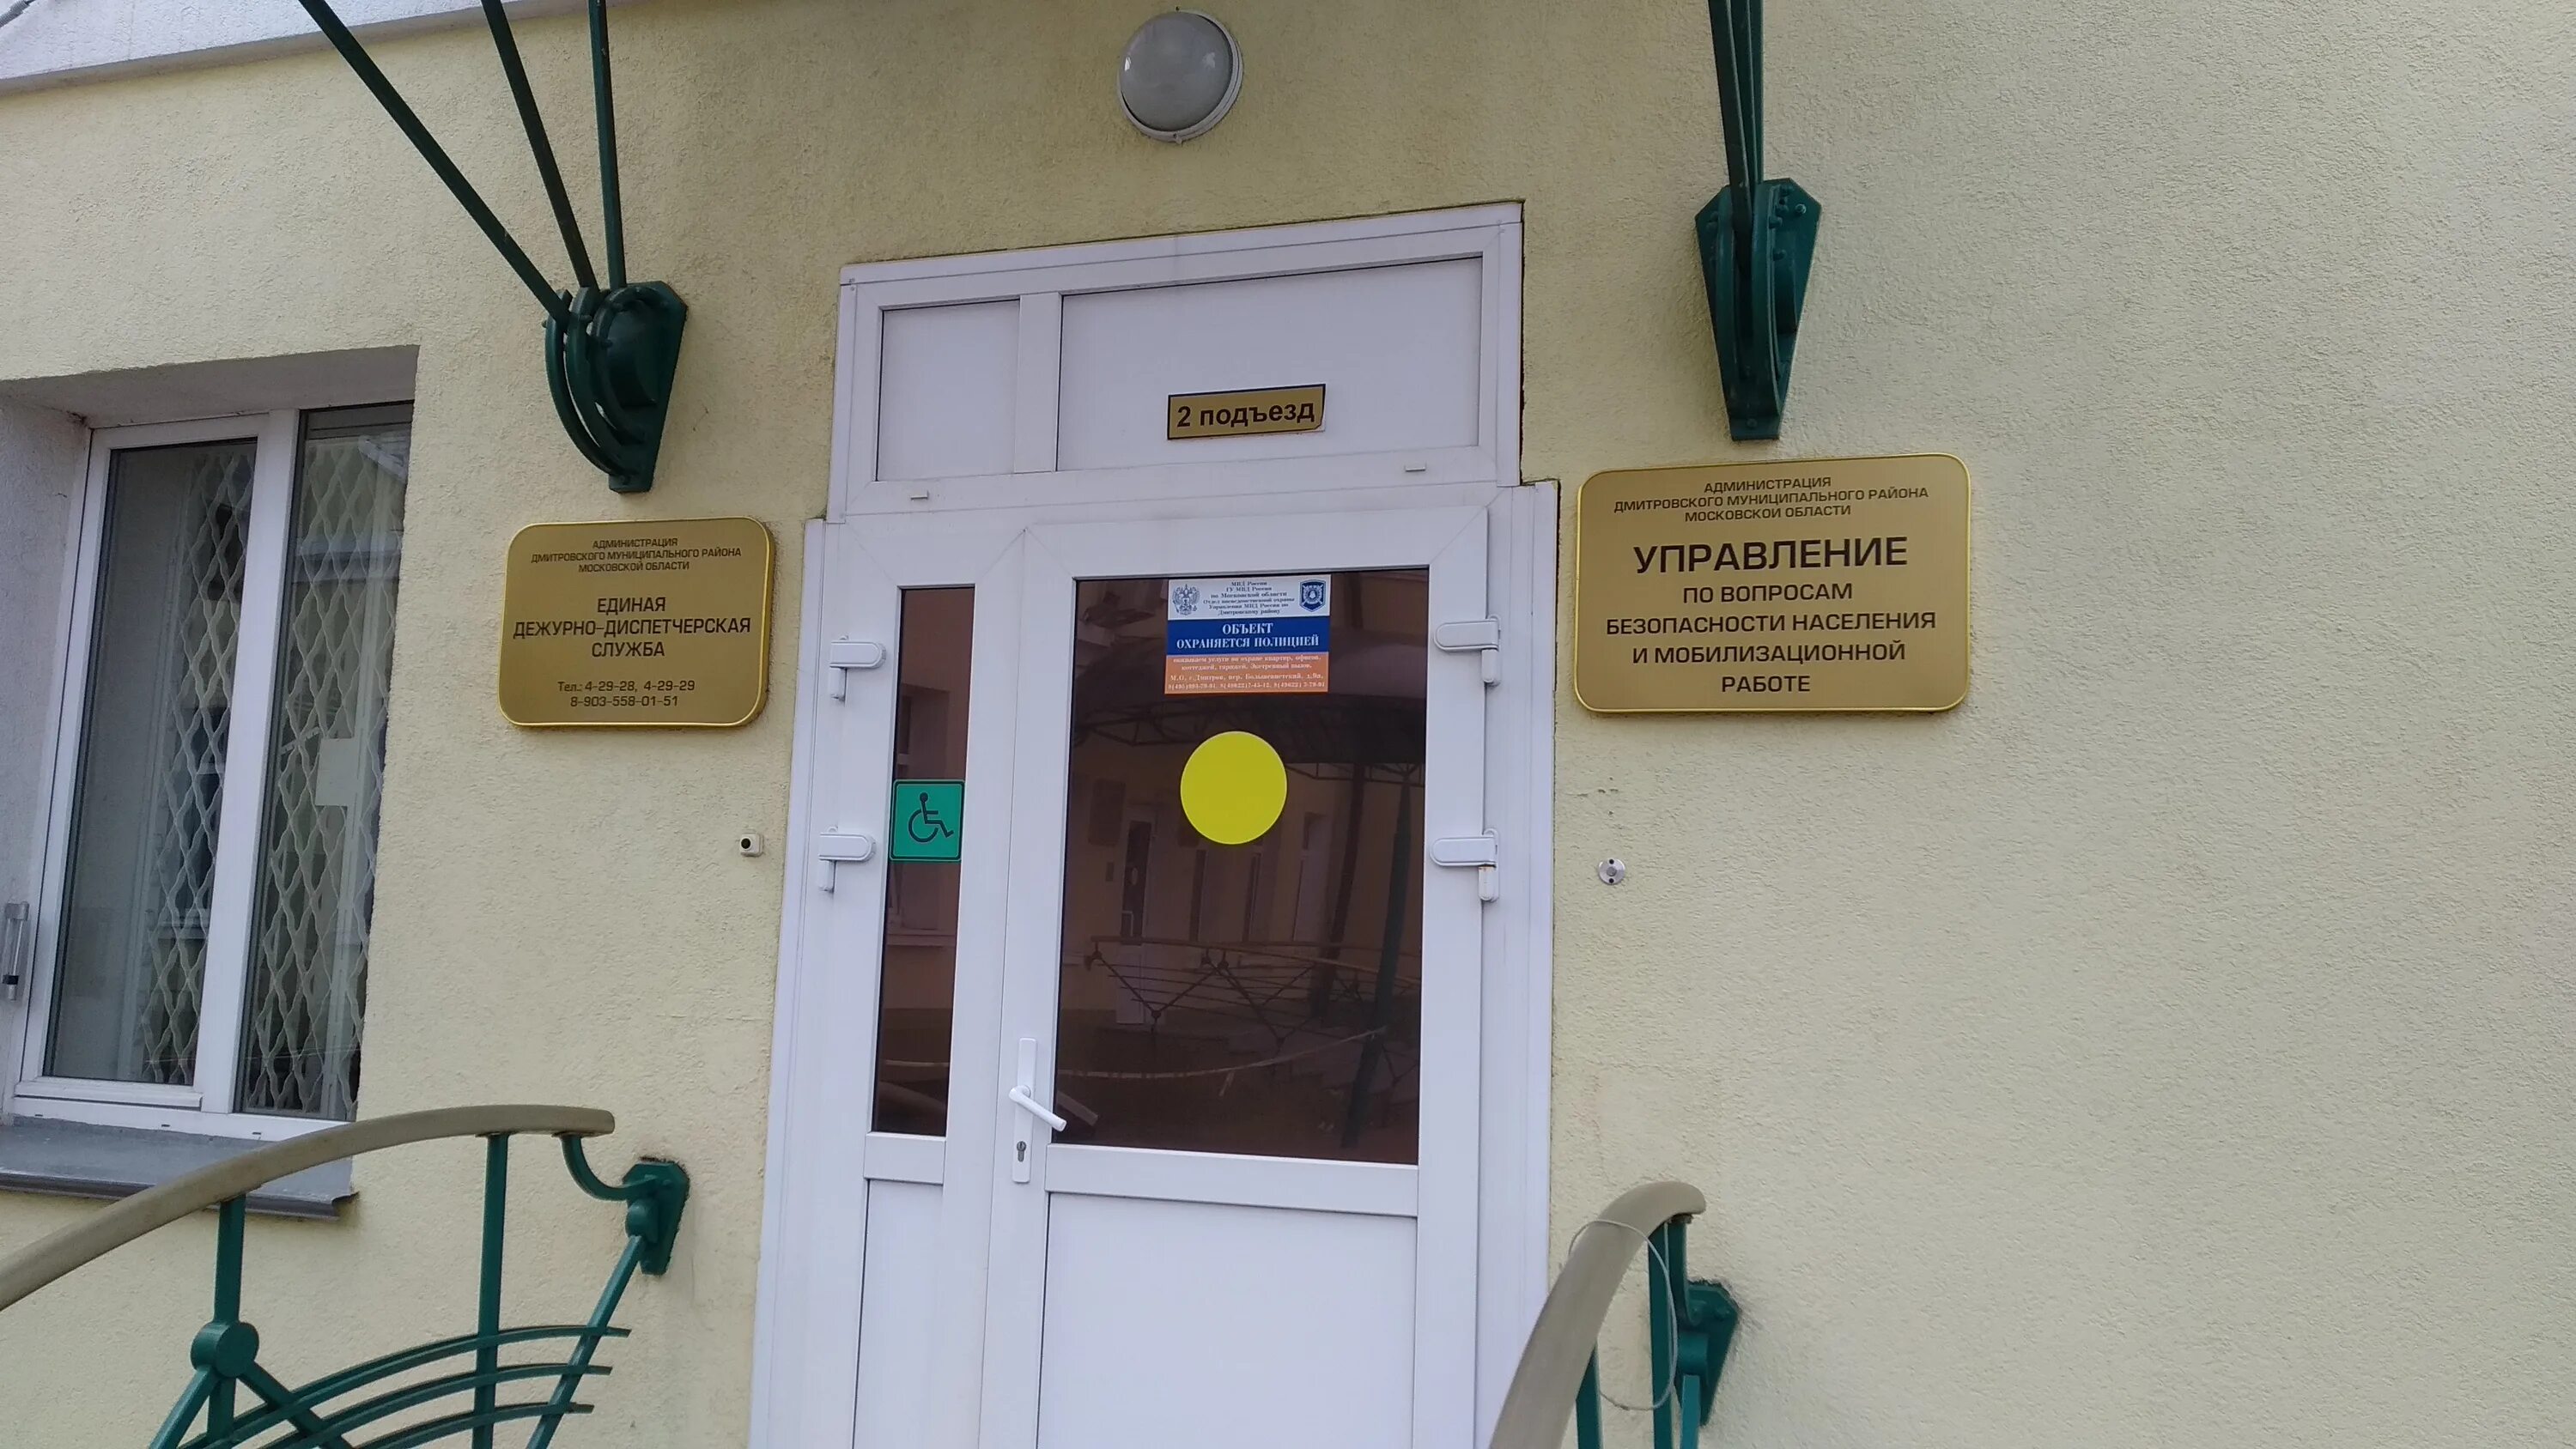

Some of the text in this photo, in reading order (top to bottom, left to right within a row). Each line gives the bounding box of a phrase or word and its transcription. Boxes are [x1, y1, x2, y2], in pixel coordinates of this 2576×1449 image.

[1176, 403, 1315, 427] 2 подъезд
[1704, 476, 1832, 494] АДМИНИСТРАЦИЯ
[1613, 485, 1929, 513] ДМИТРОВСКОГО МУНИЦИПАЛЬНОГО РАЙОНА
[1785, 505, 1851, 517] ОБЛАСТИ
[592, 537, 678, 549] АДМИНИСТРАЦИЯ
[531, 547, 741, 563] ДМИТРОВСКОГО МУНИЦИПАЛЬНОГО РАЙОНА
[1633, 536, 1908, 574] УПРАВЛЕНИЕ
[578, 561, 690, 573] МОСКОВСКОЙ ОБЛАСТИ
[1683, 583, 1853, 604] ПО ВОПРОСАМ
[597, 597, 666, 615] ЕДИНАЯ
[513, 617, 751, 640] ДЕЖУРНО-ДИСПЕТЧЕРСКАЯ
[1222, 622, 1273, 634] ОБЪЕКТ
[1606, 611, 1936, 635] БЕЗОПАСНОСТИ НАСЕЛЕНИЯ
[592, 642, 665, 658] СЛУЖБА
[1176, 634, 1320, 650] ОХРАНЯЕТСЯ ПОЛИЦИЕЙ
[1632, 640, 1906, 665] И МОБИЛИЗАЦИОННОЙ
[557, 680, 696, 693] Тел.: 4-29-28, 4-29-29
[1721, 675, 1810, 693] РАБОТЕ
[570, 695, 678, 707] 8-903-558-01-51
